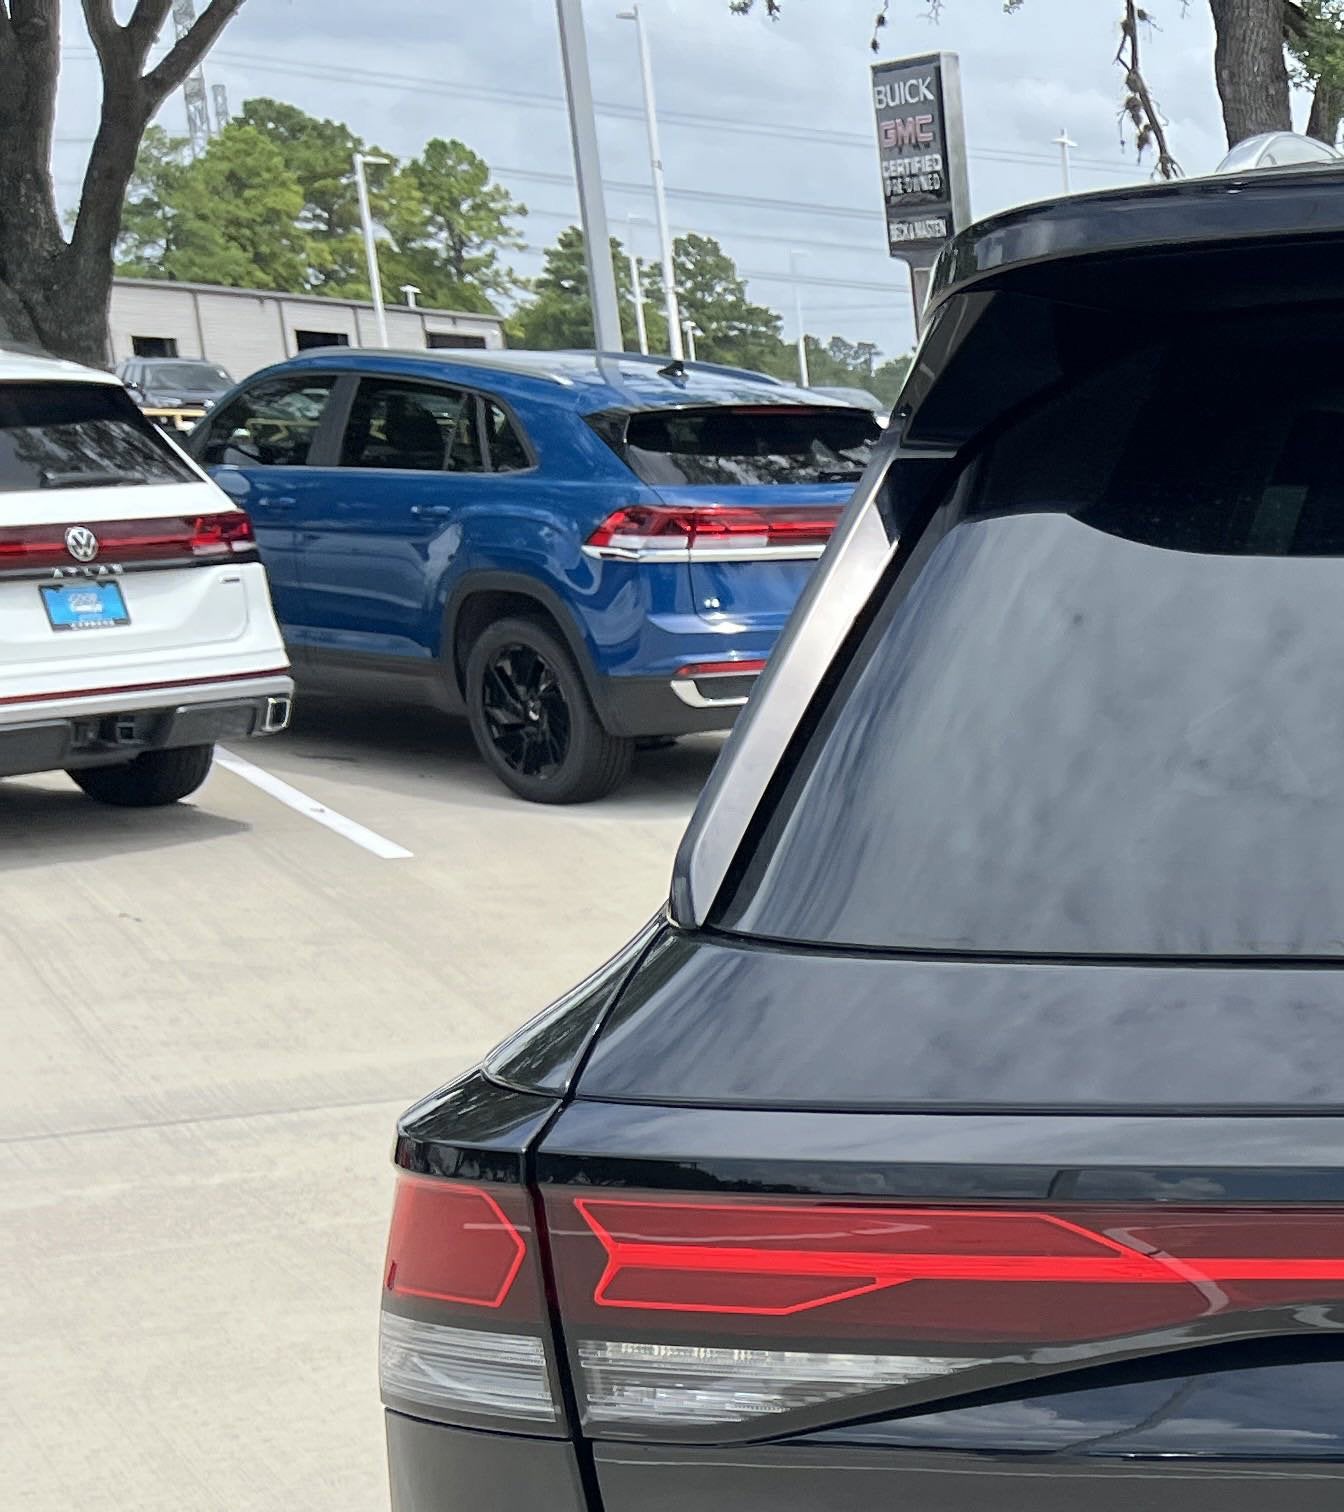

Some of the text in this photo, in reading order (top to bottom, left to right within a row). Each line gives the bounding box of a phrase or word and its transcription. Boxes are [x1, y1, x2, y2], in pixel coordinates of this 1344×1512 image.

[874, 76, 935, 110] BUICK
[881, 114, 934, 148] GMC
[882, 153, 942, 179] CERTIFIED
